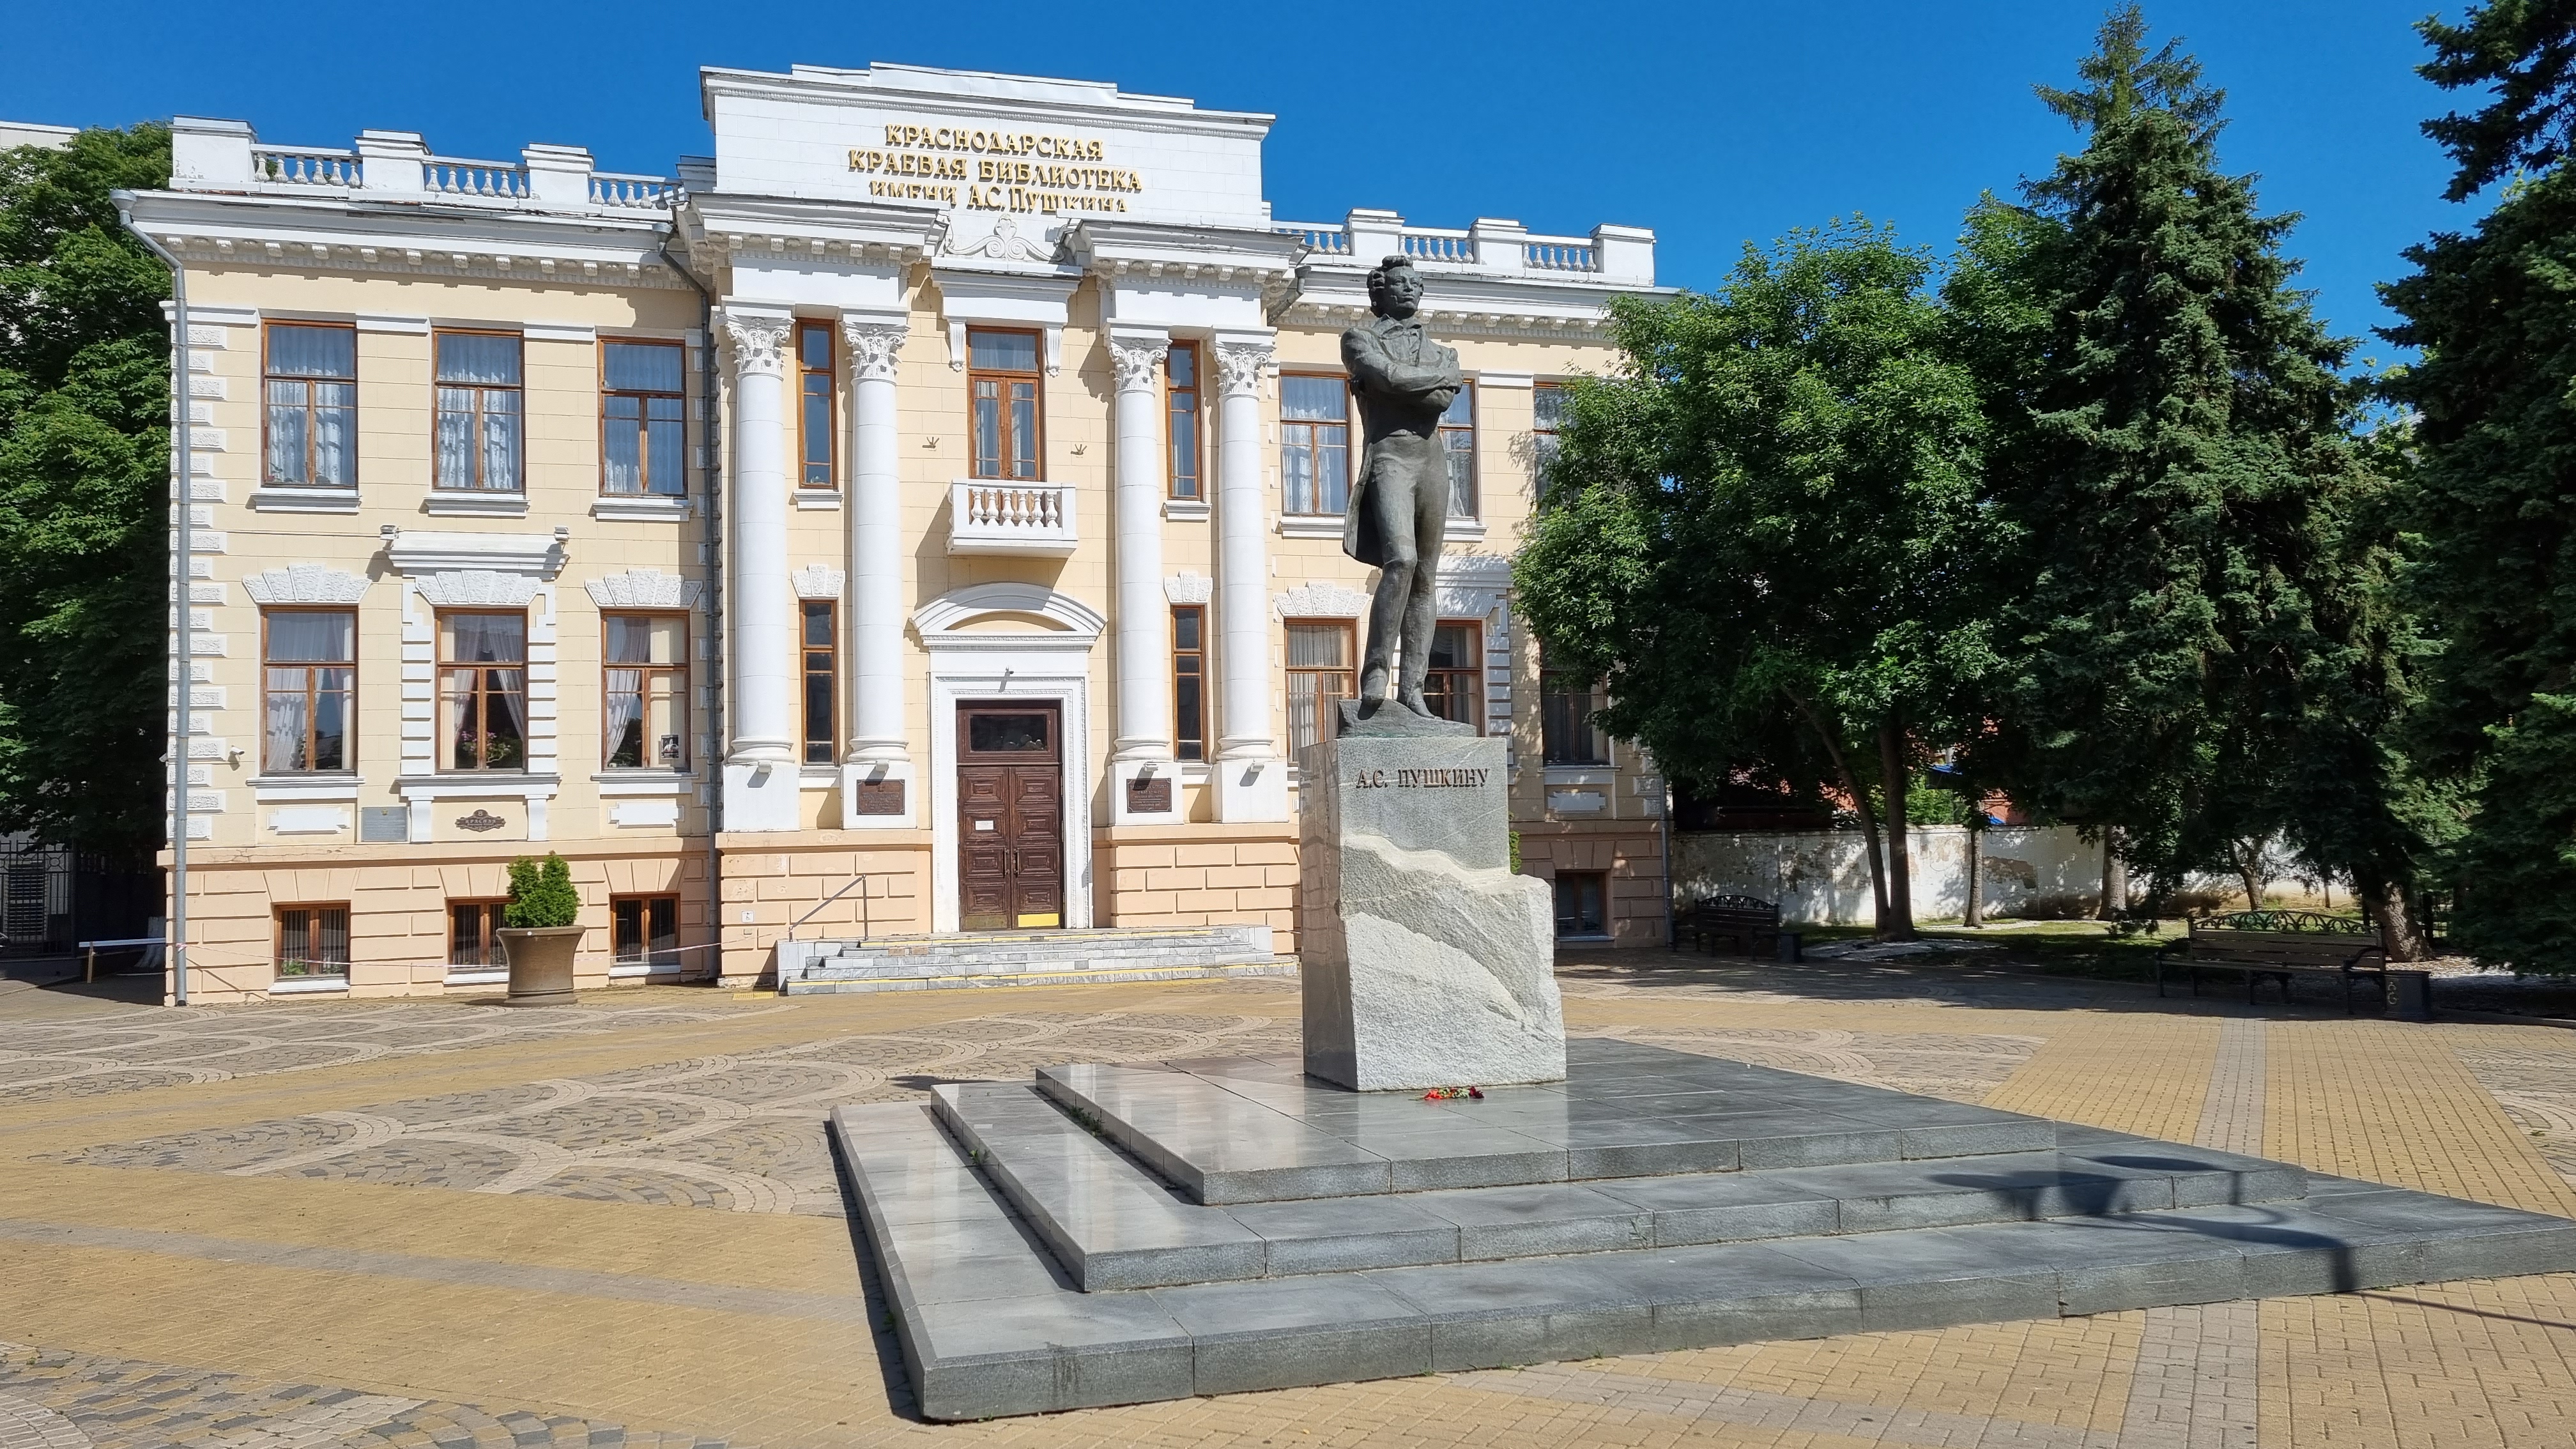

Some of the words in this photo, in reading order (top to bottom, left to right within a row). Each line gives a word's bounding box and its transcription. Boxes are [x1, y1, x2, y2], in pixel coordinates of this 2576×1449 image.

[885, 124, 1103, 160] КРАСНОДАРСКАЯ
[848, 150, 967, 179] КРАЕВАЯ
[979, 160, 1142, 192] БИБЛИОТЕКА
[870, 180, 956, 206] ИМЕНИ
[1356, 769, 1388, 788] А.С.
[1398, 768, 1489, 788] ПУШКИНУ
